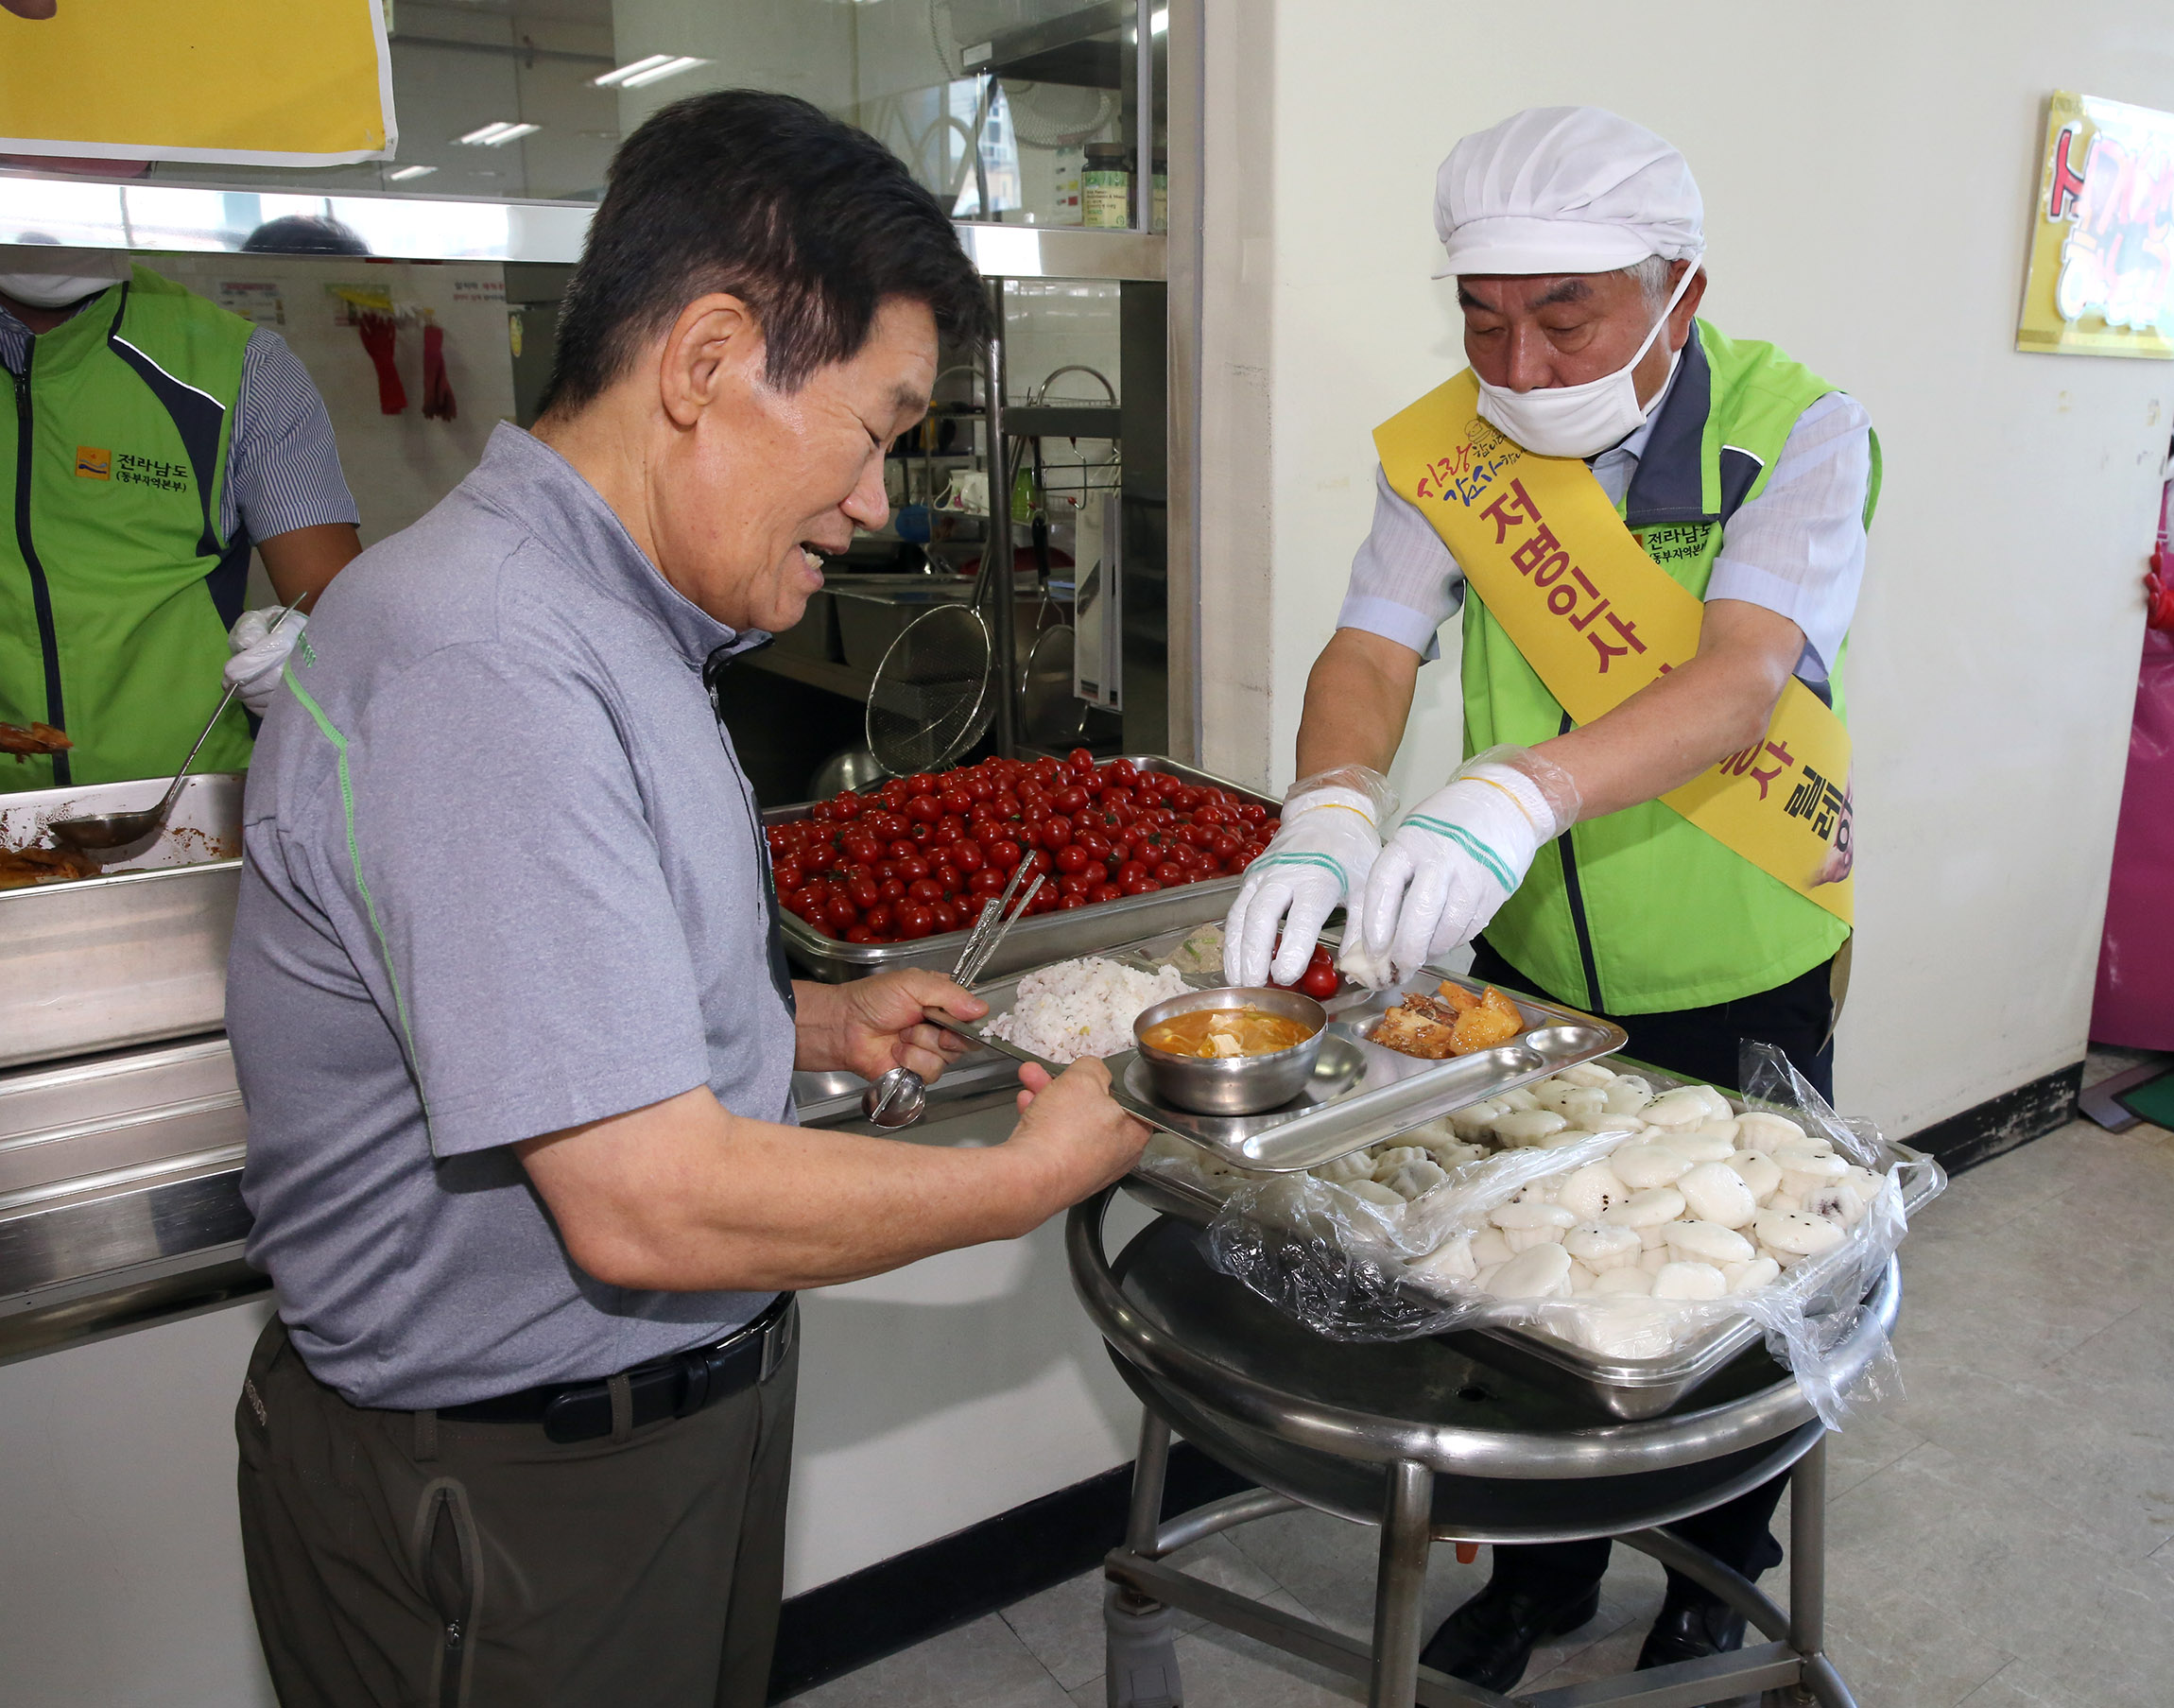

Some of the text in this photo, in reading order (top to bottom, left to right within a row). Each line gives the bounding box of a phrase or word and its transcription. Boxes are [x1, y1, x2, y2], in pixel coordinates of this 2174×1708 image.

[116, 471, 187, 492] (동부지역본부)
[117, 454, 188, 477] 전라남도
[1443, 447, 1527, 507] 감사합니
[1479, 477, 1648, 673] 저명인사
